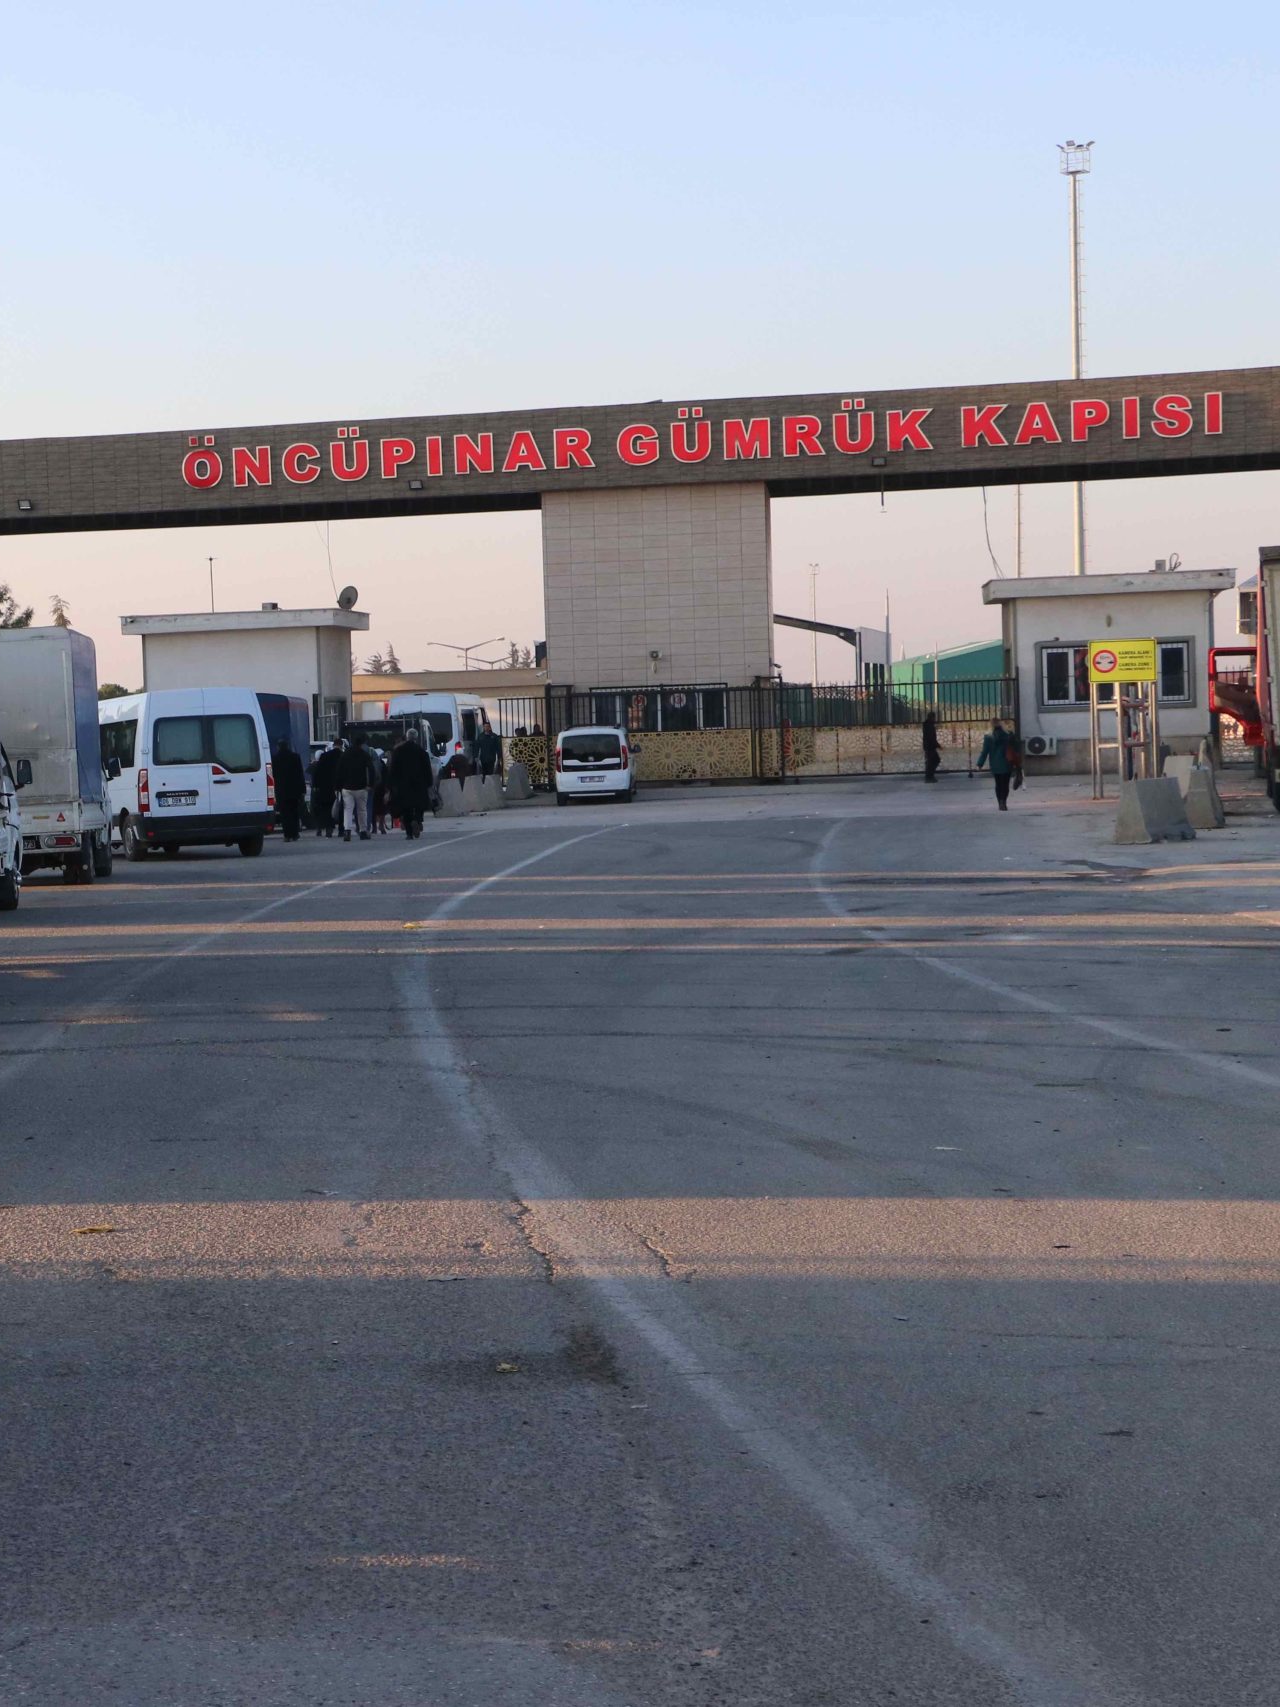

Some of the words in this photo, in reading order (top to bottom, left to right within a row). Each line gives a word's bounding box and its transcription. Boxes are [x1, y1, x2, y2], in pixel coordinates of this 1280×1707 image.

[182, 426, 596, 490] ÖNCÜPINAR
[616, 398, 934, 467] GÜMRÜK
[961, 391, 1223, 449] KAPISI
